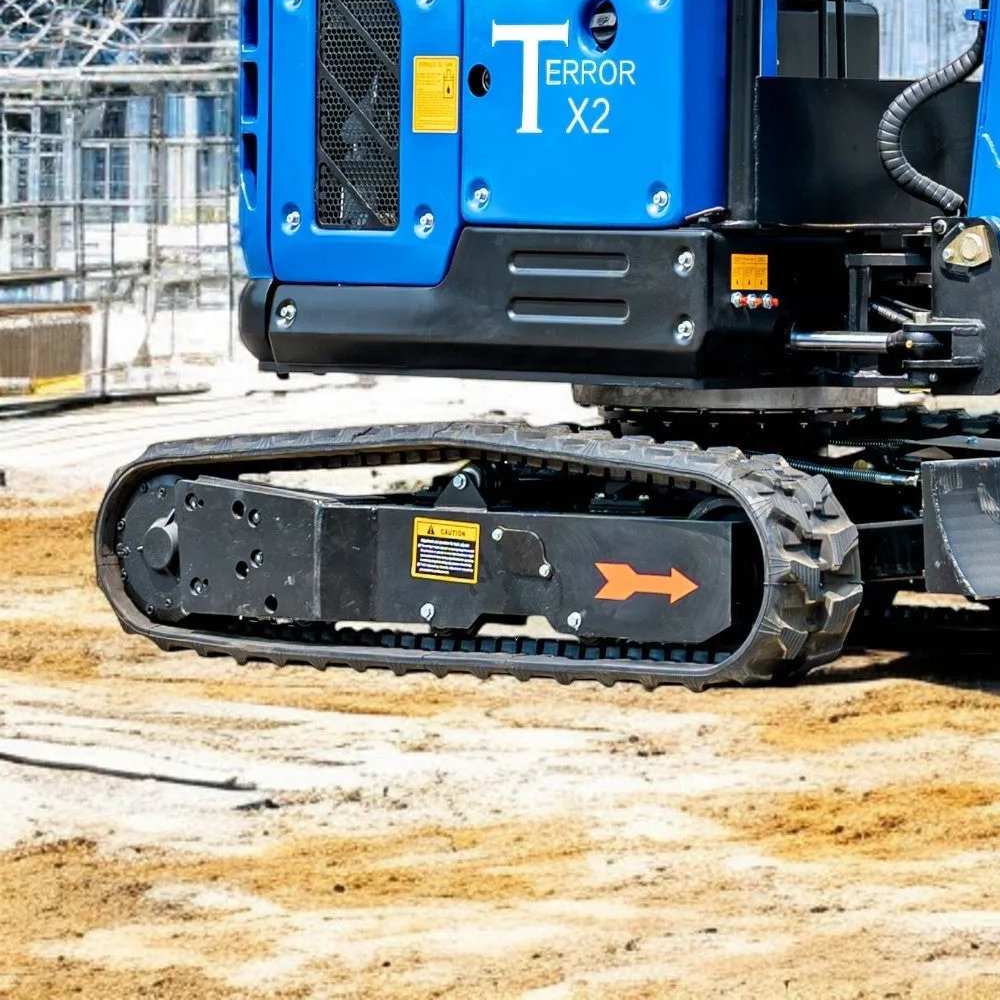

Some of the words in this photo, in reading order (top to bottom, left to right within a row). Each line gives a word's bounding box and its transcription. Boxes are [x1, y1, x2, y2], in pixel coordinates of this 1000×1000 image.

[492, 19, 636, 133] TERROR
[565, 97, 610, 134] X2
[440, 528, 466, 537] CAUTION
